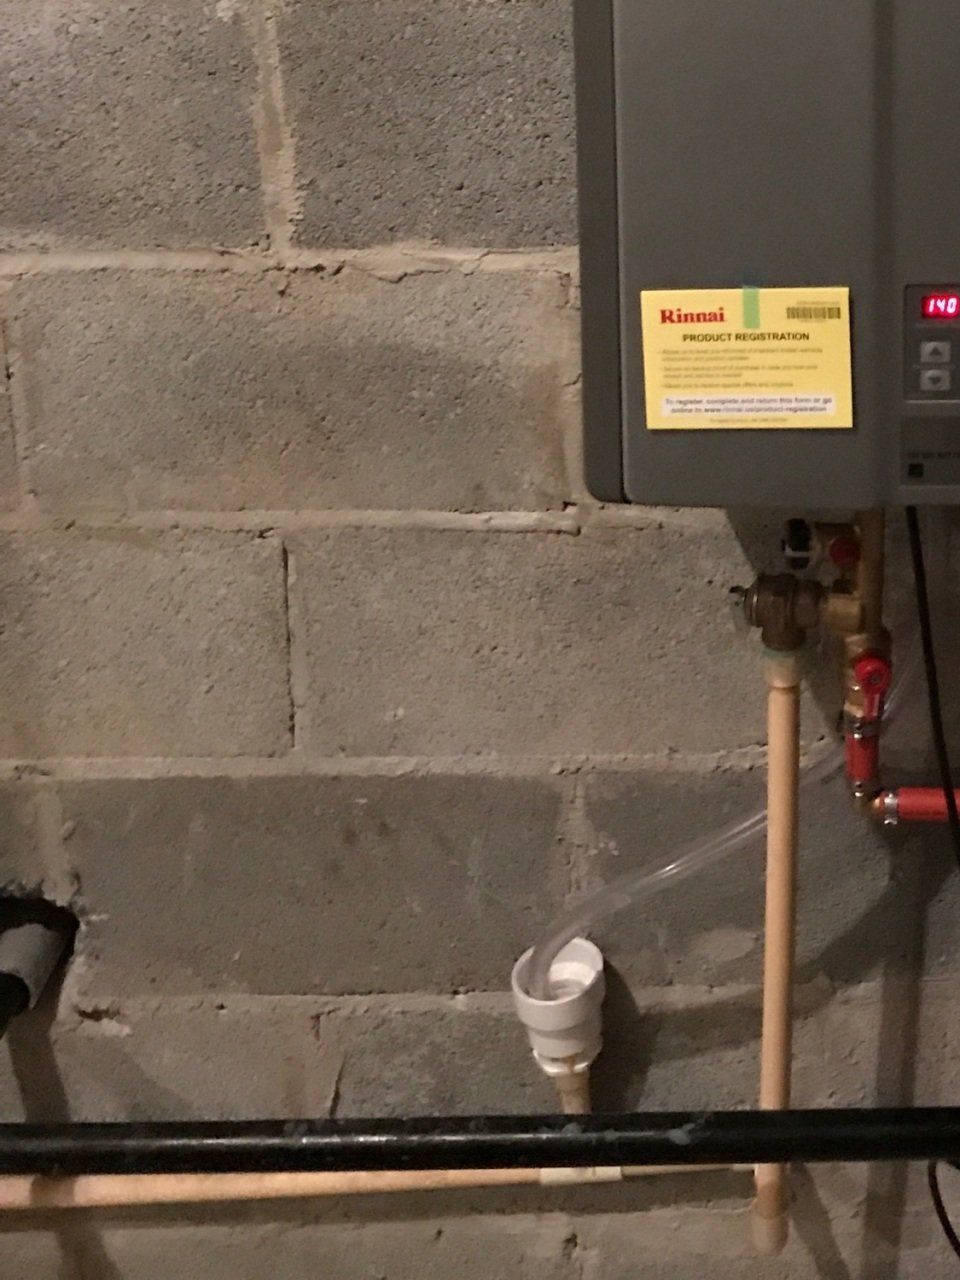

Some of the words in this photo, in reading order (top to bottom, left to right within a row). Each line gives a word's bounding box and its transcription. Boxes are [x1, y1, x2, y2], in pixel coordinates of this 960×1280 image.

[928, 297, 957, 313] 140
[660, 307, 725, 324] Rinnai
[682, 333, 732, 342] PRODUCT
[735, 332, 810, 341] REGISTRATION
